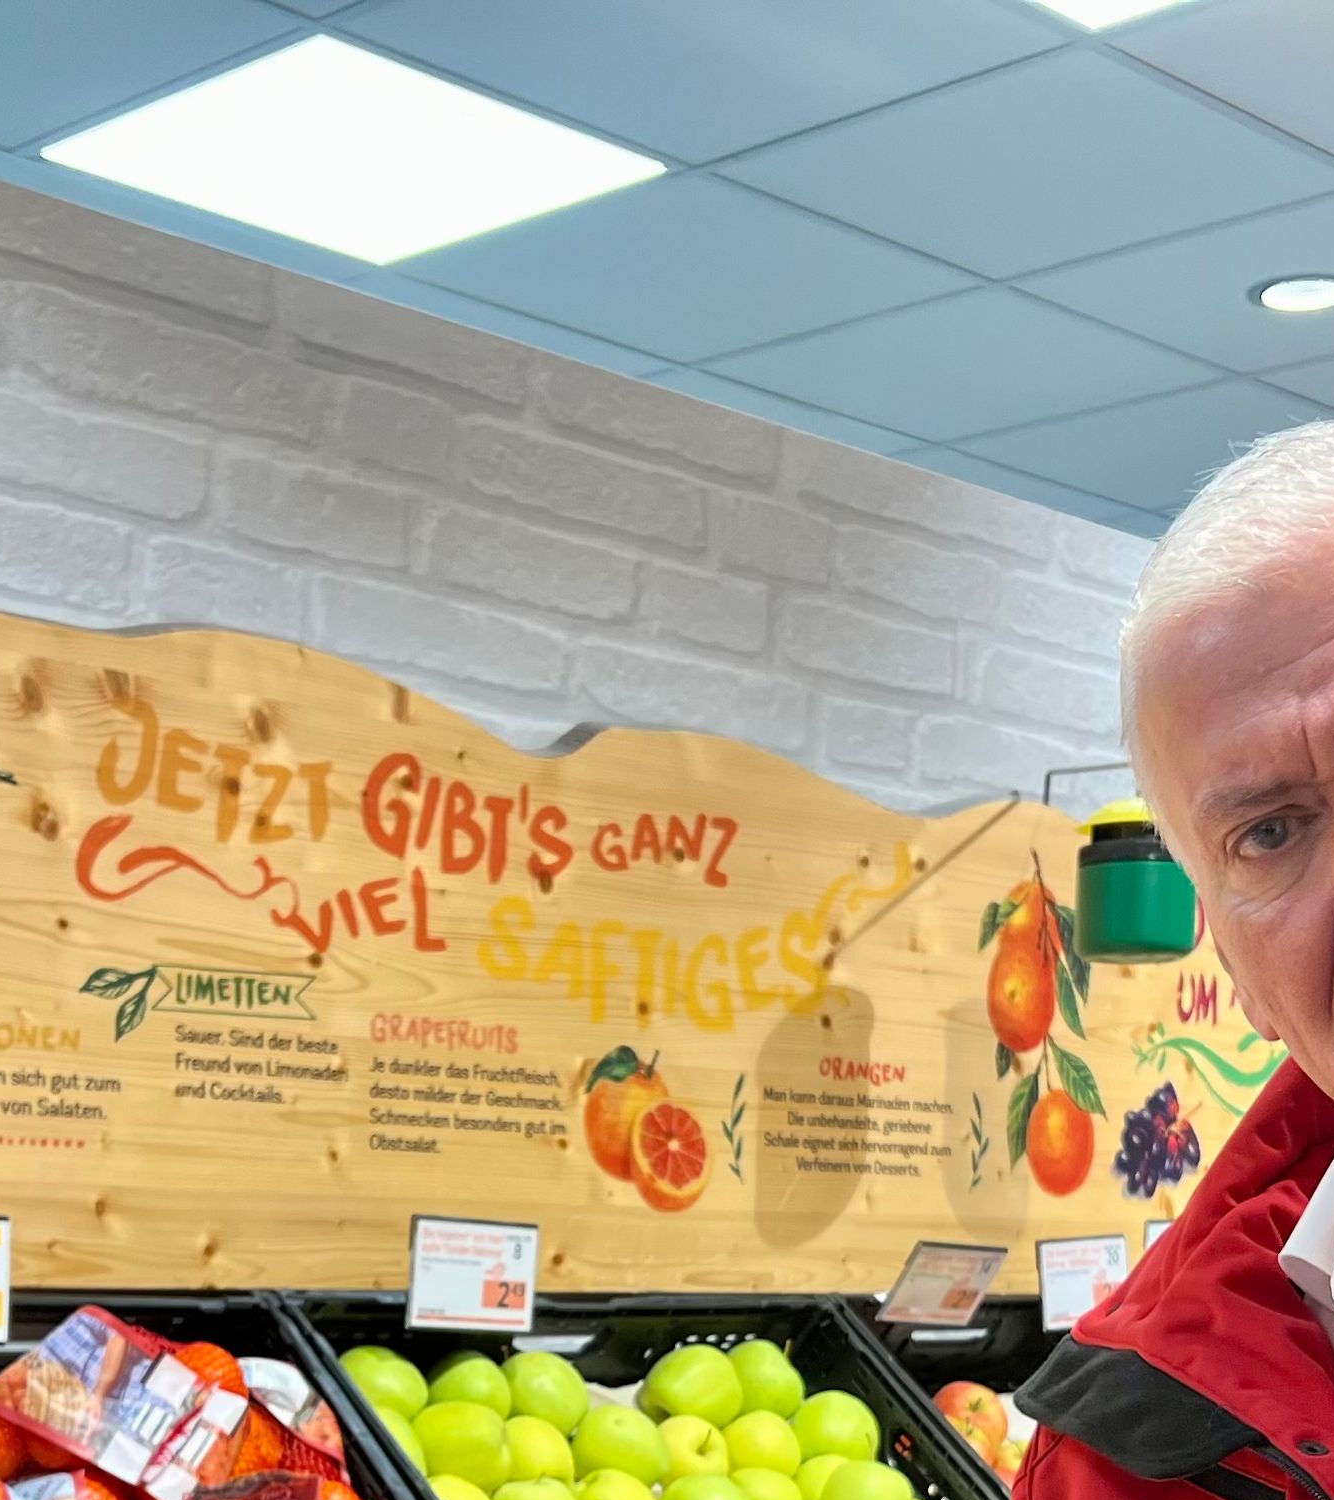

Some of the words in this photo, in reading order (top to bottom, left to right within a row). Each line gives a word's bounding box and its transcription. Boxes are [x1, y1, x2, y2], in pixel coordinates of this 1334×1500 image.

[95, 696, 333, 845] JETZT
[361, 753, 574, 885] GIBT'S
[590, 814, 739, 888] GANZ
[271, 868, 447, 953] VIEL
[475, 890, 849, 1033] SAFTIGES
[175, 972, 293, 1010] LIMETTEN
[1177, 971, 1217, 1027] UM
[370, 1011, 519, 1054] GRAPEFRUITS
[12, 1066, 46, 1088] sich
[51, 1073, 80, 1094] gut
[85, 1076, 122, 1093] zum
[175, 1052, 231, 1073] Freund
[819, 1056, 906, 1087] ORANGEN
[0, 1099, 33, 1117] von
[37, 1098, 108, 1121] Salaten.
